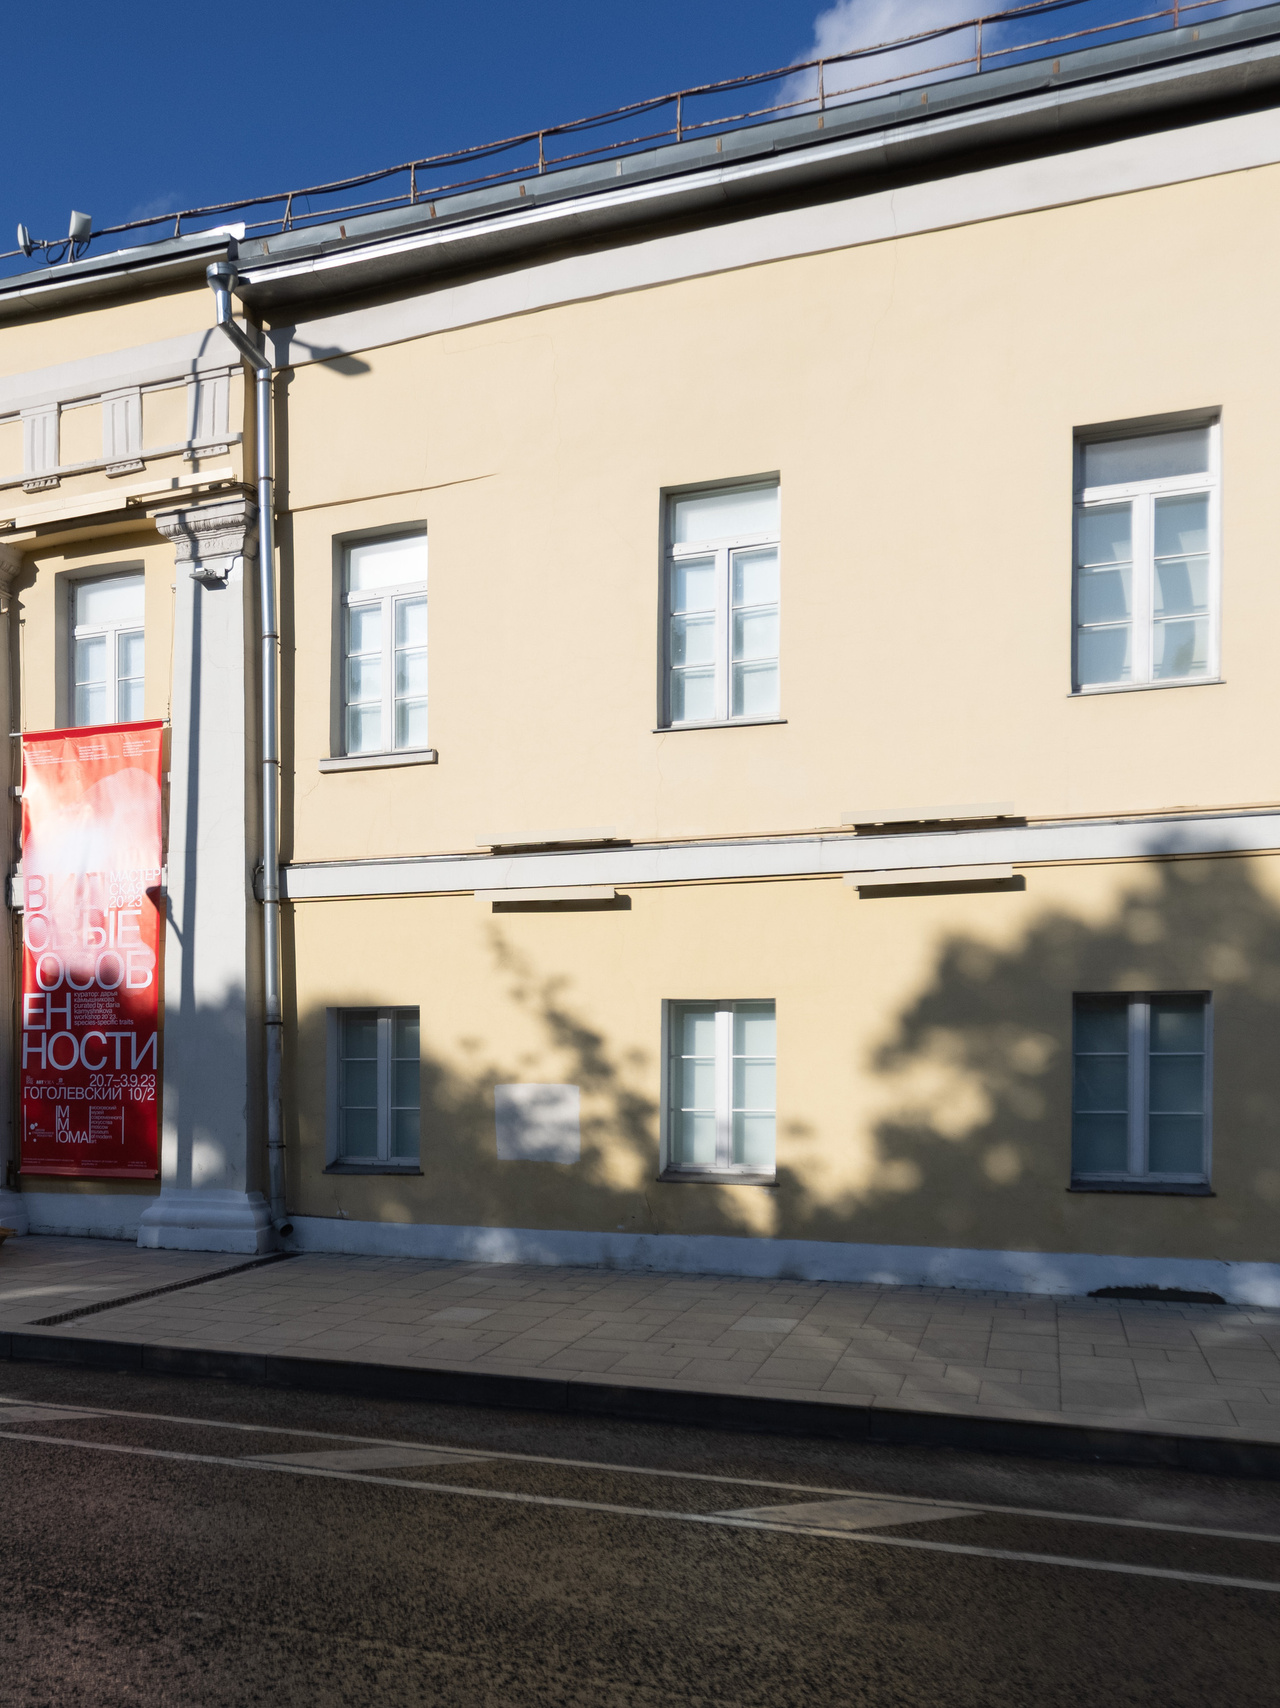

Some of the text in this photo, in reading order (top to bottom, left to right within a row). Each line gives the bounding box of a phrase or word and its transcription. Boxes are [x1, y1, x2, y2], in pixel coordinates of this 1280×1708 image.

[109, 868, 161, 882] МАСТЕР
[109, 882, 144, 896] СКАЯ
[24, 909, 142, 952] ОВЫЕ
[35, 950, 154, 991] ОСОБ
[22, 992, 72, 1031] ЕН
[22, 1030, 158, 1071] НОСТИ
[24, 1085, 155, 1103] ГОГОЛЕВСКИЙ 10/2
